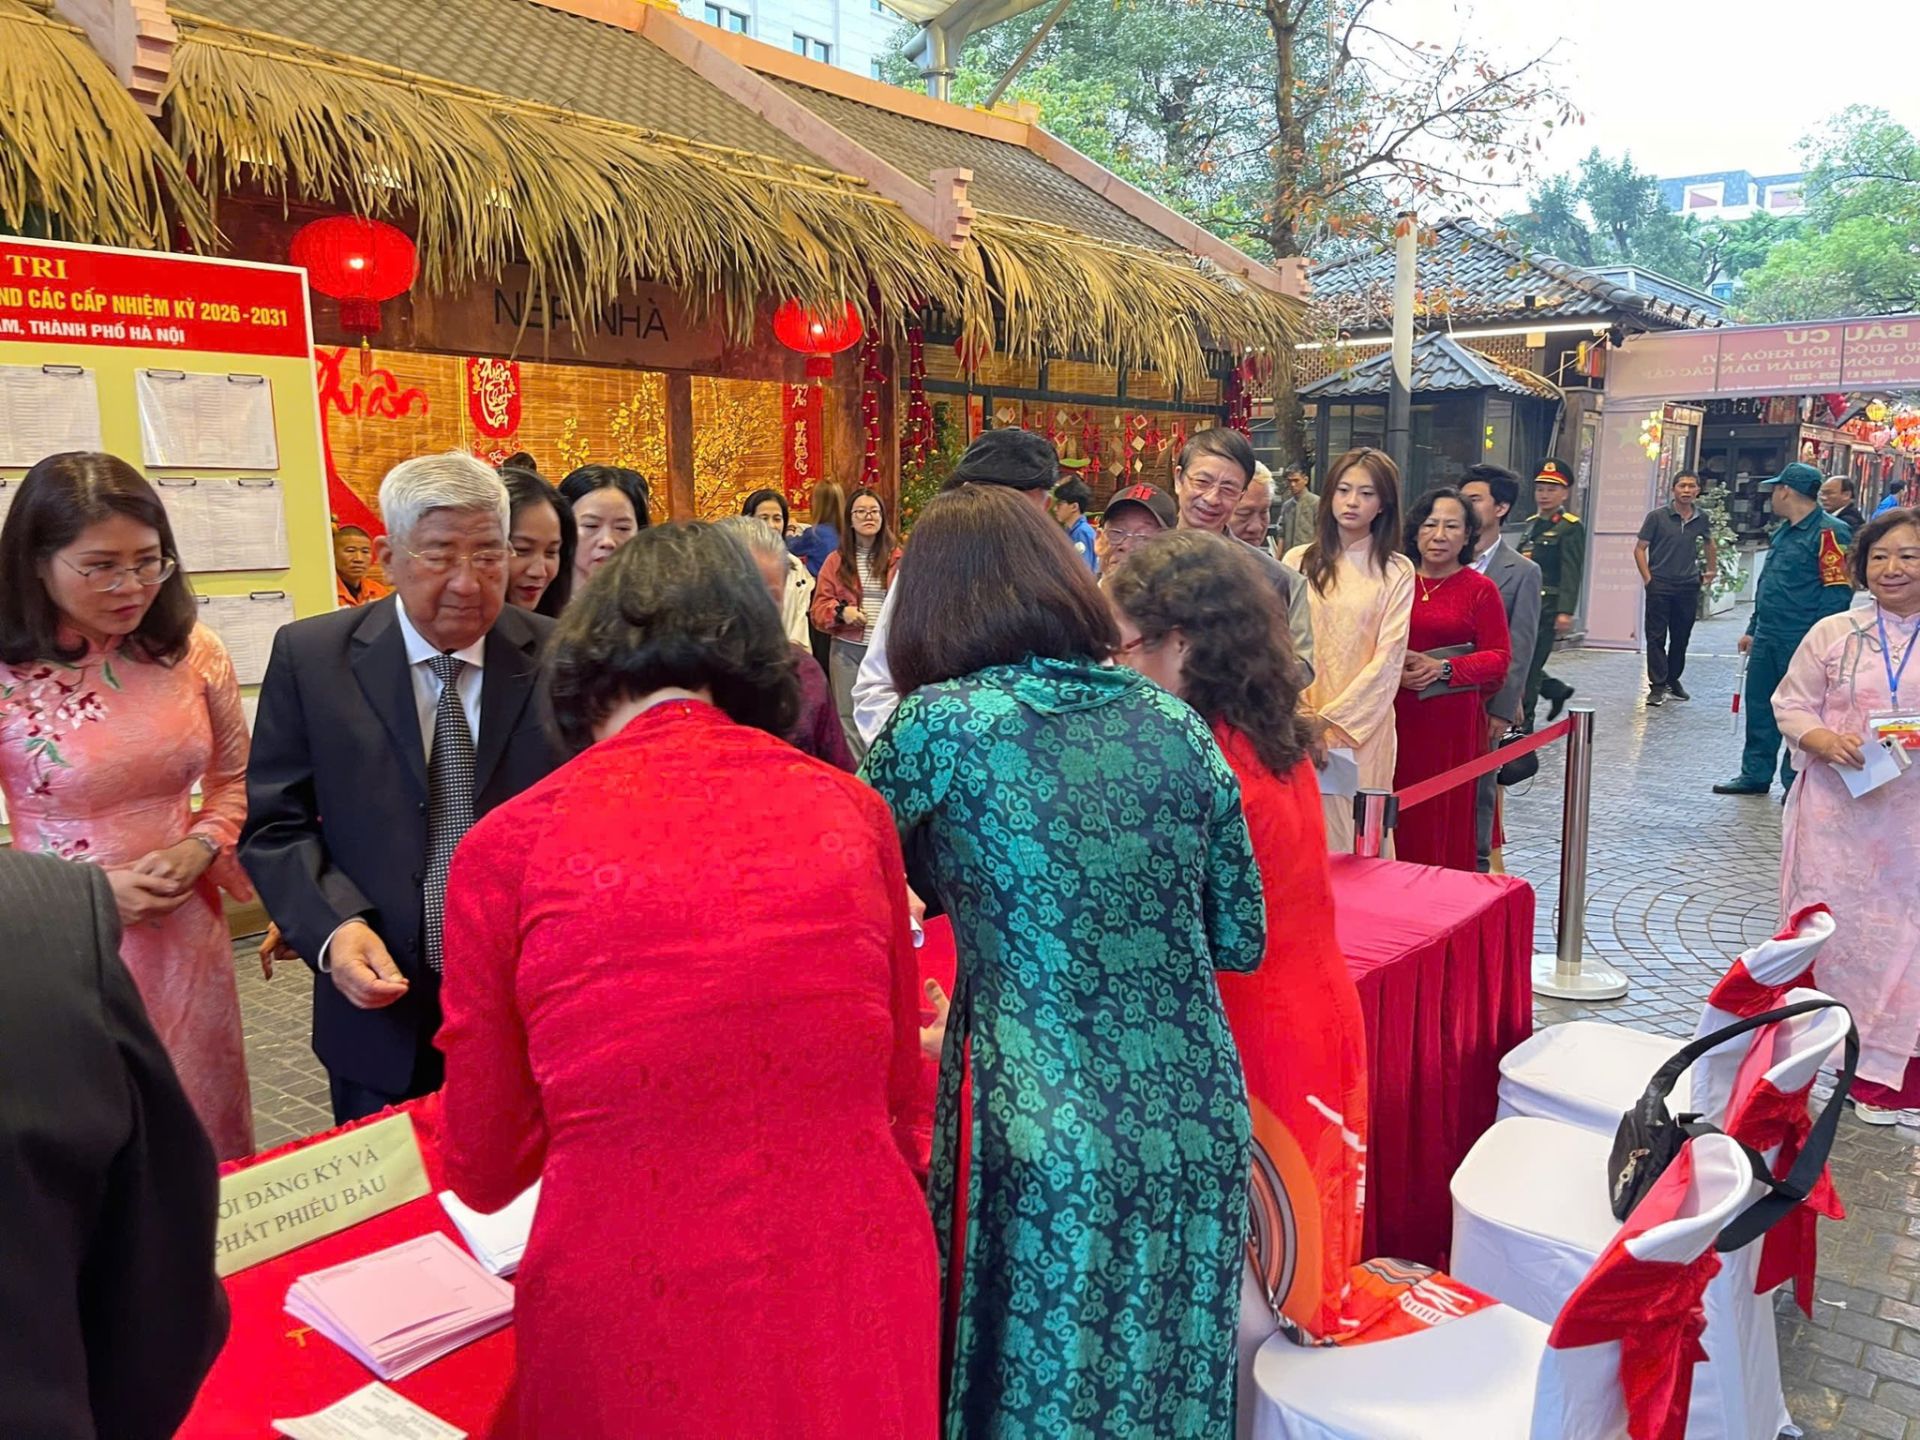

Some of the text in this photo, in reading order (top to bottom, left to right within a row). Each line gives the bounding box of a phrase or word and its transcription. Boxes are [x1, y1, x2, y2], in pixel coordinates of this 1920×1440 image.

[6, 255, 68, 280] TRI
[28, 286, 66, 311] CÁC
[71, 287, 108, 313] CẤP
[112, 293, 170, 320] NHIỆM
[594, 298, 669, 342] NHÀ
[0, 319, 185, 345] M, THÀNH PHỐ HÀ NỘI
[245, 1173, 310, 1210] ĐĂNG
[313, 1155, 342, 1184] KÝ
[347, 1143, 379, 1169] VÀ
[274, 1194, 339, 1233] PHIẾU
[341, 1175, 387, 1206] BẦU
